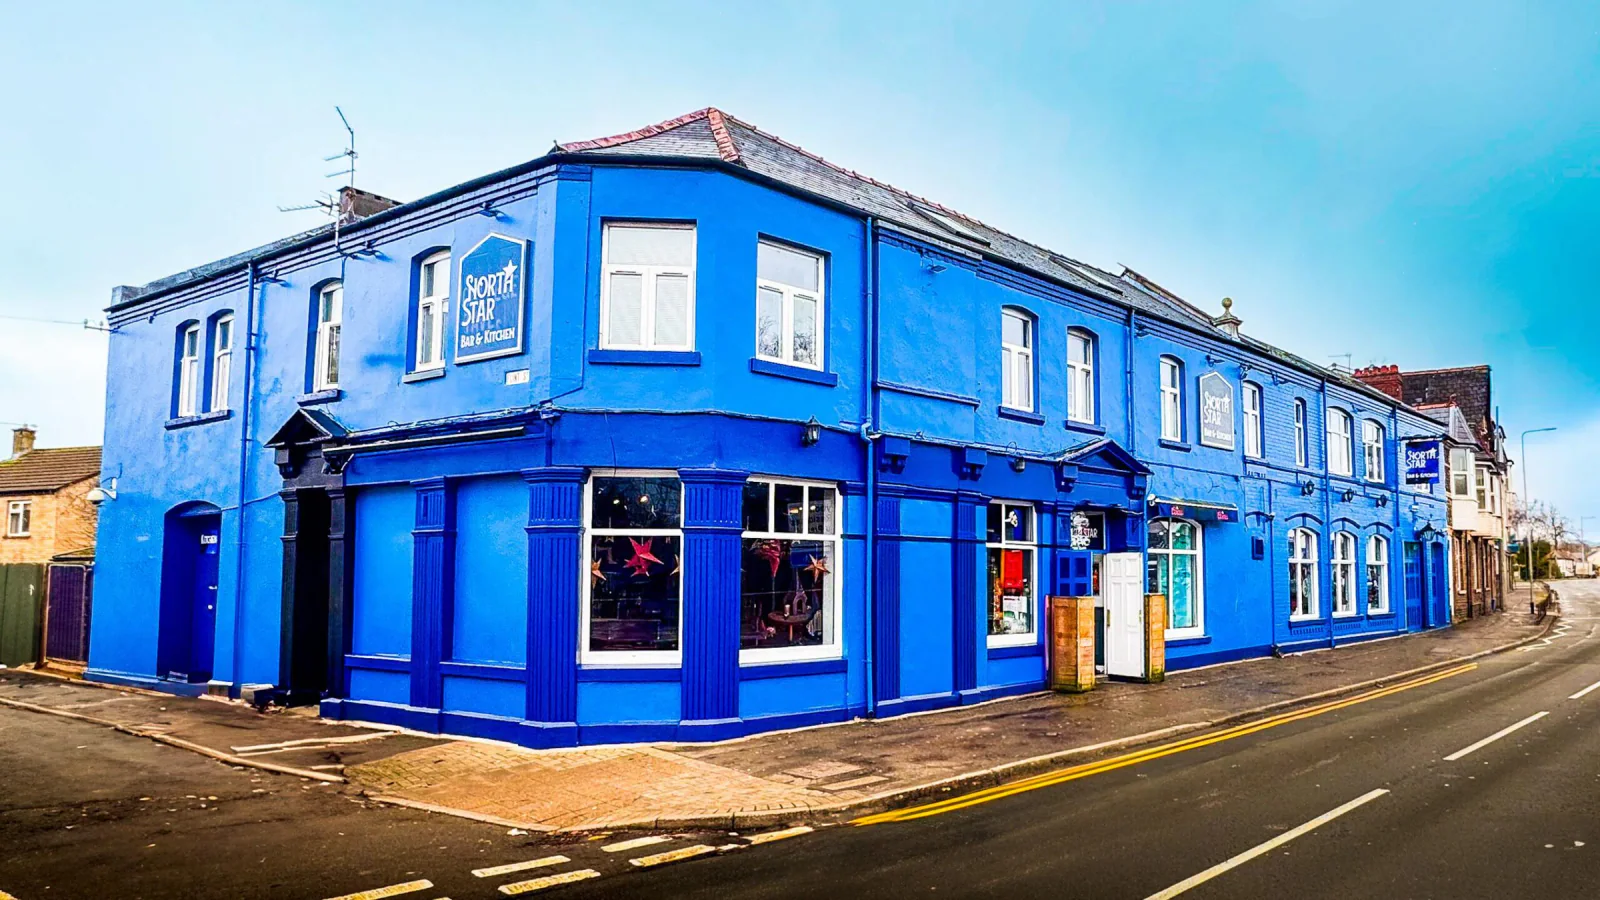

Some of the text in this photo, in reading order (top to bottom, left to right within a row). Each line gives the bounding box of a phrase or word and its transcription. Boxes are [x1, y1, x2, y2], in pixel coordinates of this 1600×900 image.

[466, 269, 514, 300] NORTH
[461, 298, 495, 327] STAR
[475, 332, 484, 346] &
[1203, 406, 1221, 425] STAR
[1406, 459, 1427, 469] STAR
